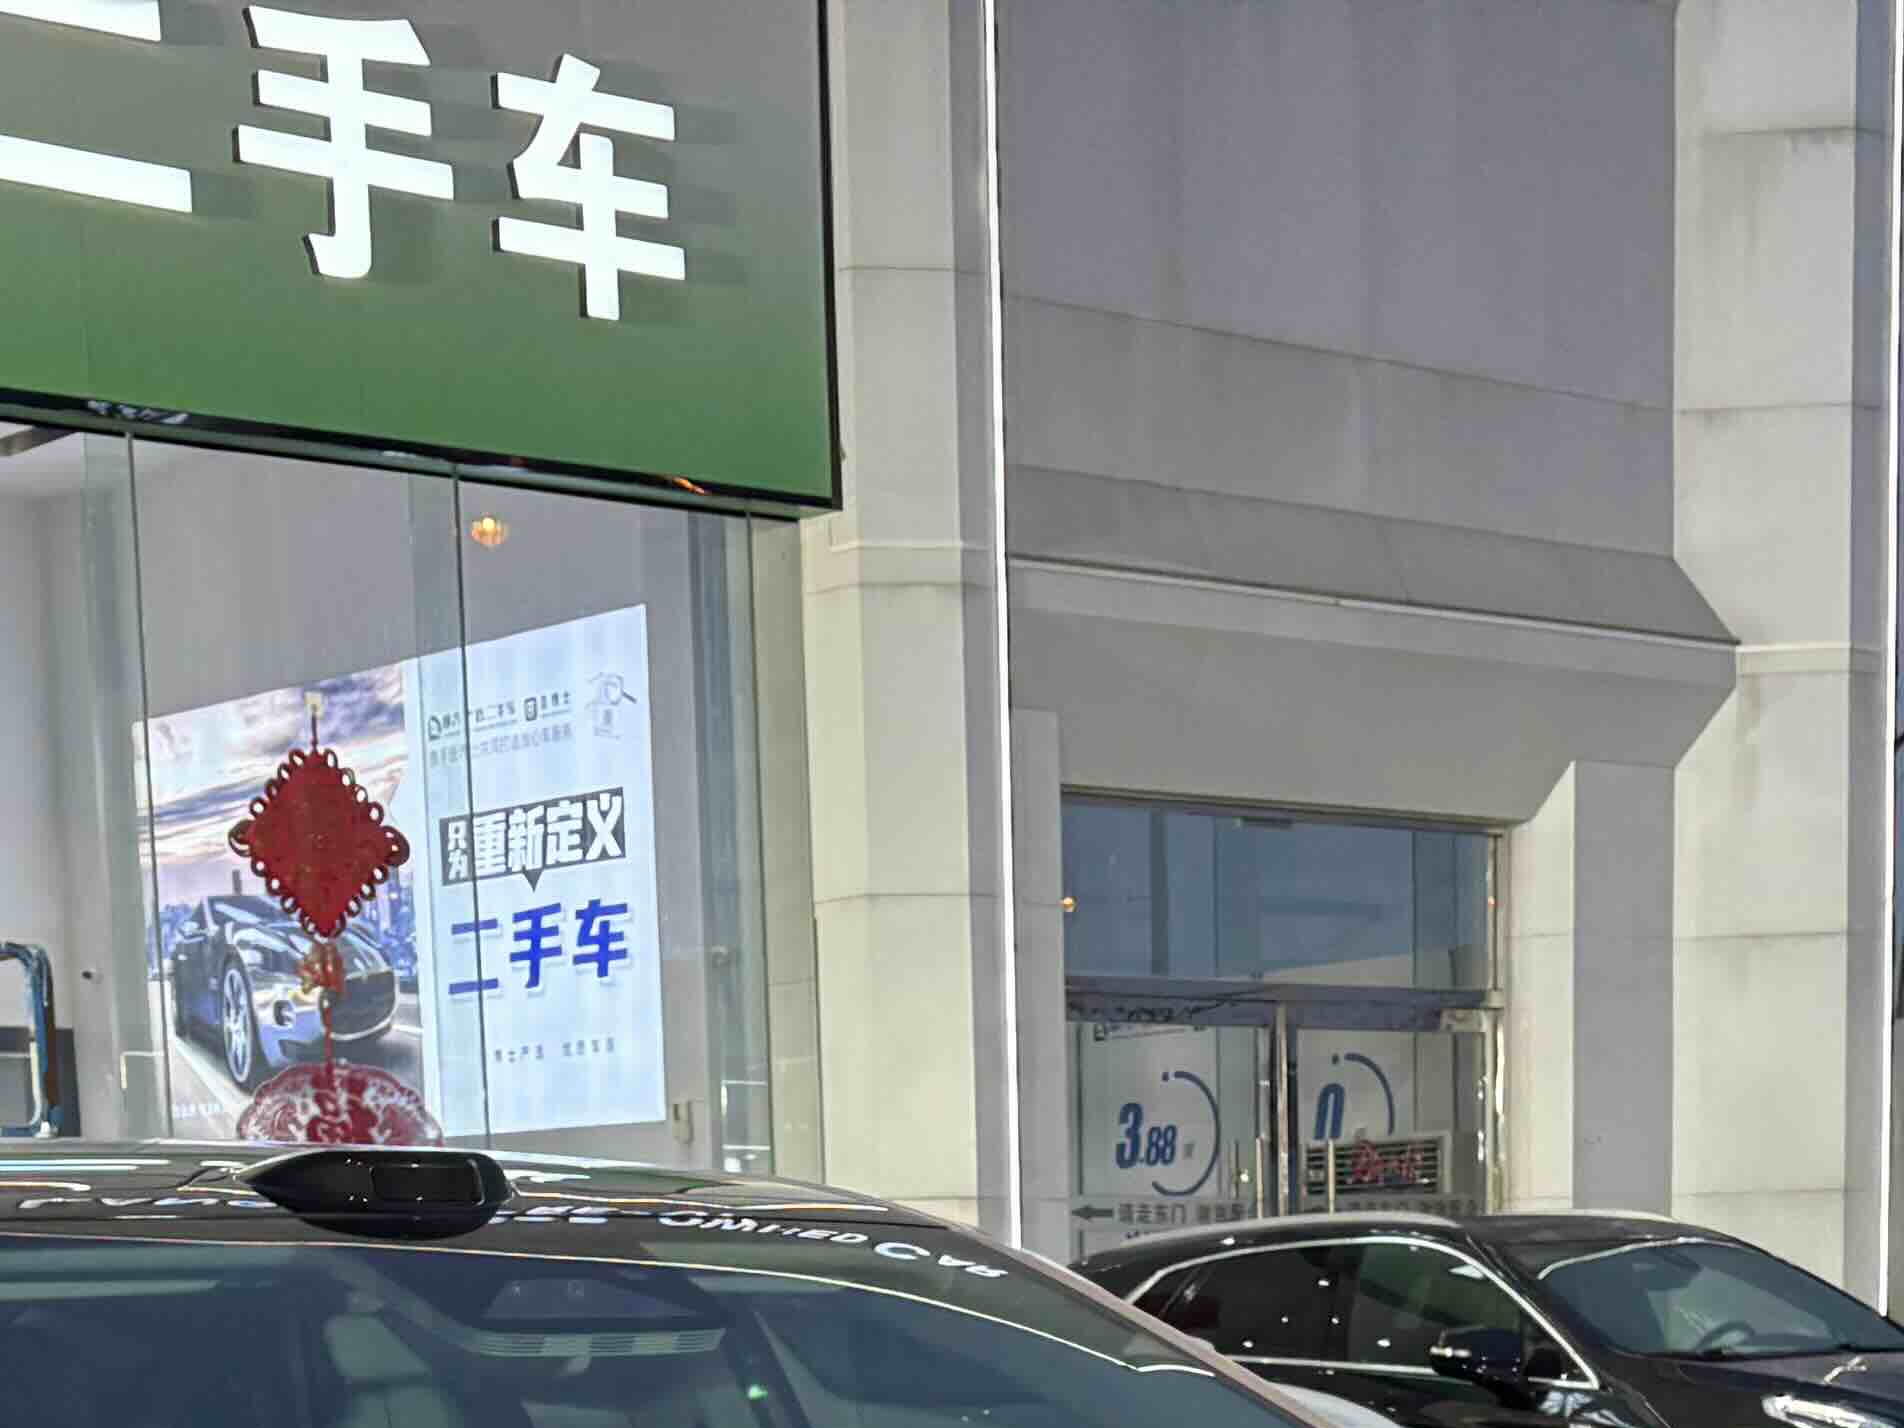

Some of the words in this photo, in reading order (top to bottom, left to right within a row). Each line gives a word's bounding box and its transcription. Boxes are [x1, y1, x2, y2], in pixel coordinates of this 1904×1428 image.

[472, 792, 623, 874] 重新定义
[447, 898, 629, 995] 二手车
[1115, 1102, 1178, 1169] 3.88
